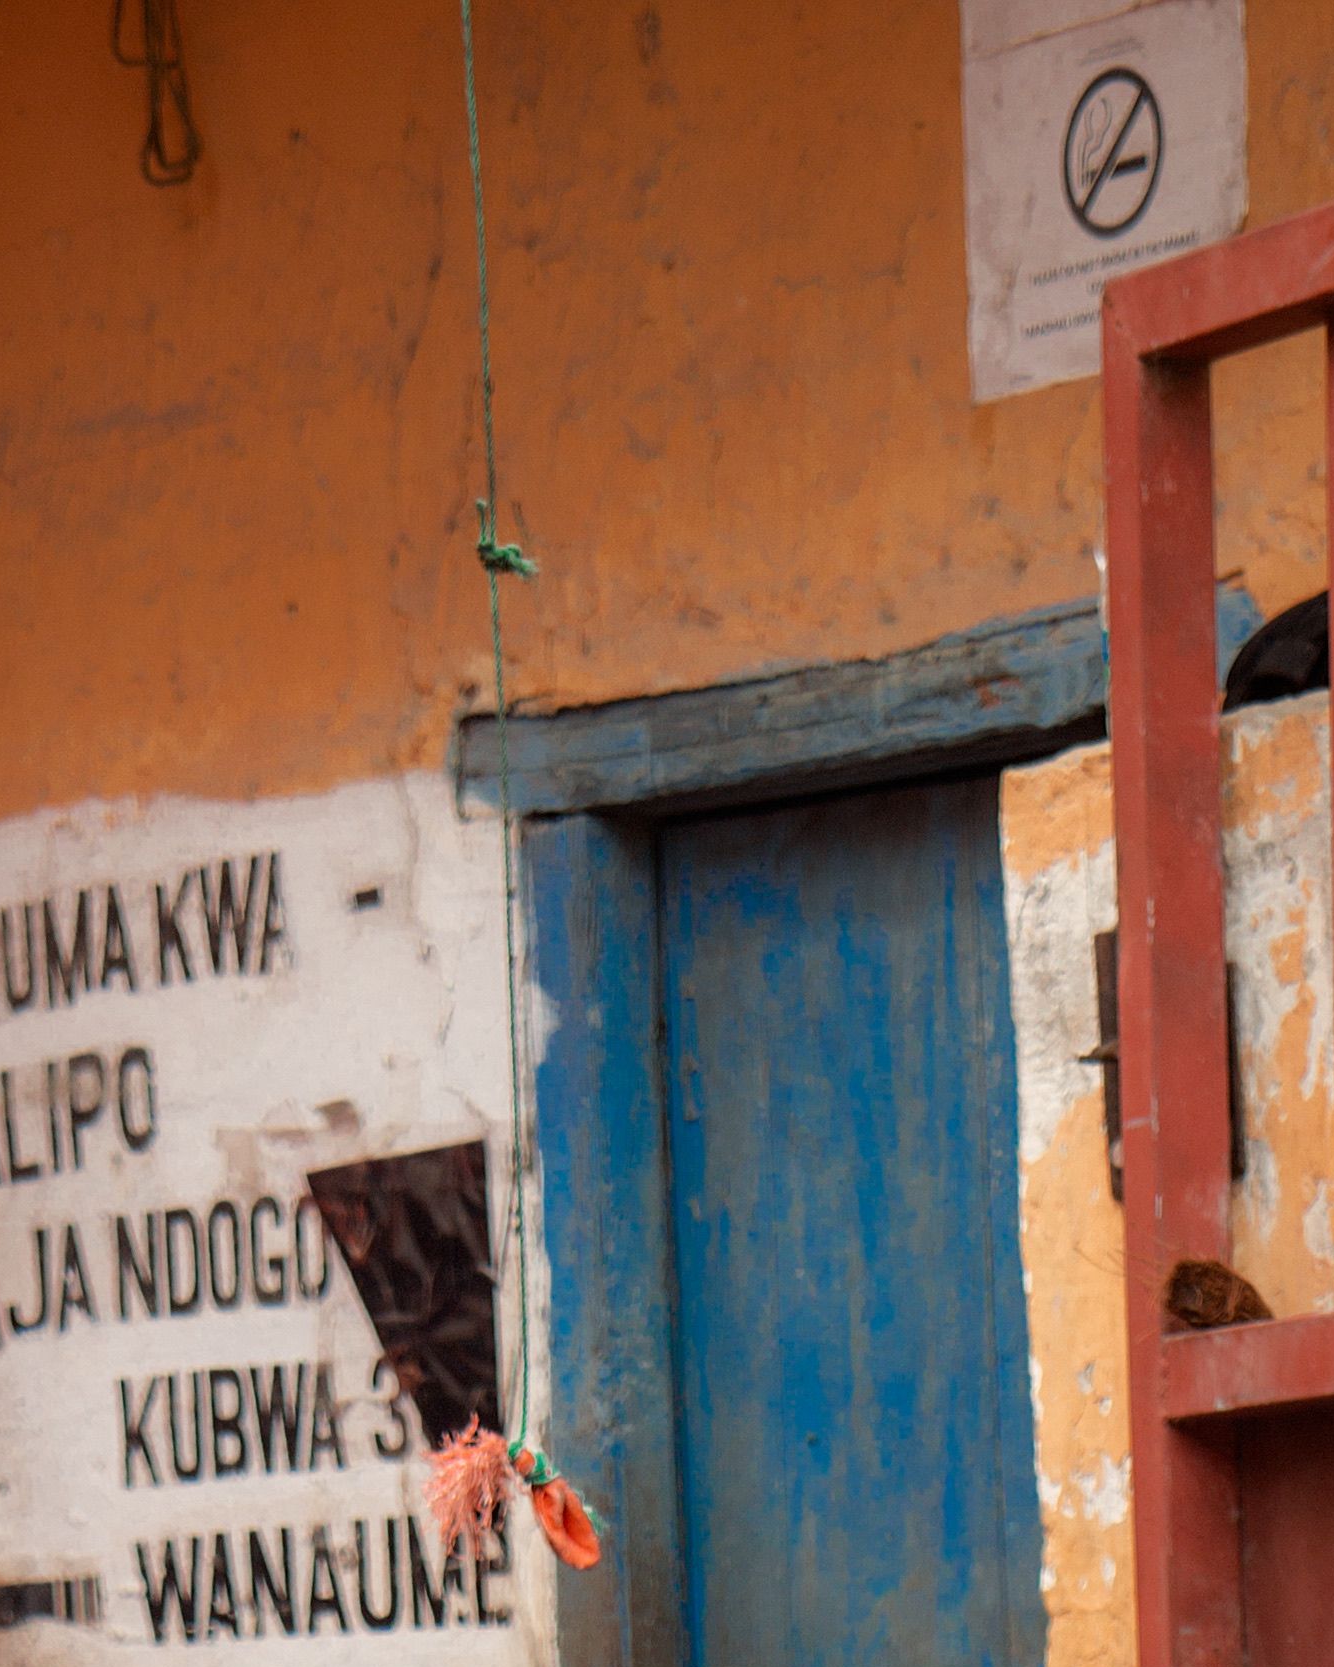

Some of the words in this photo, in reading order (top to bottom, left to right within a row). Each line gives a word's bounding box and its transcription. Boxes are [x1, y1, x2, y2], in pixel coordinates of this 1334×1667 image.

[155, 851, 296, 988] KWA
[111, 1195, 331, 1323] NDOGO
[119, 1361, 348, 1488] KUBWA
[136, 1499, 512, 1645] WANAUME
